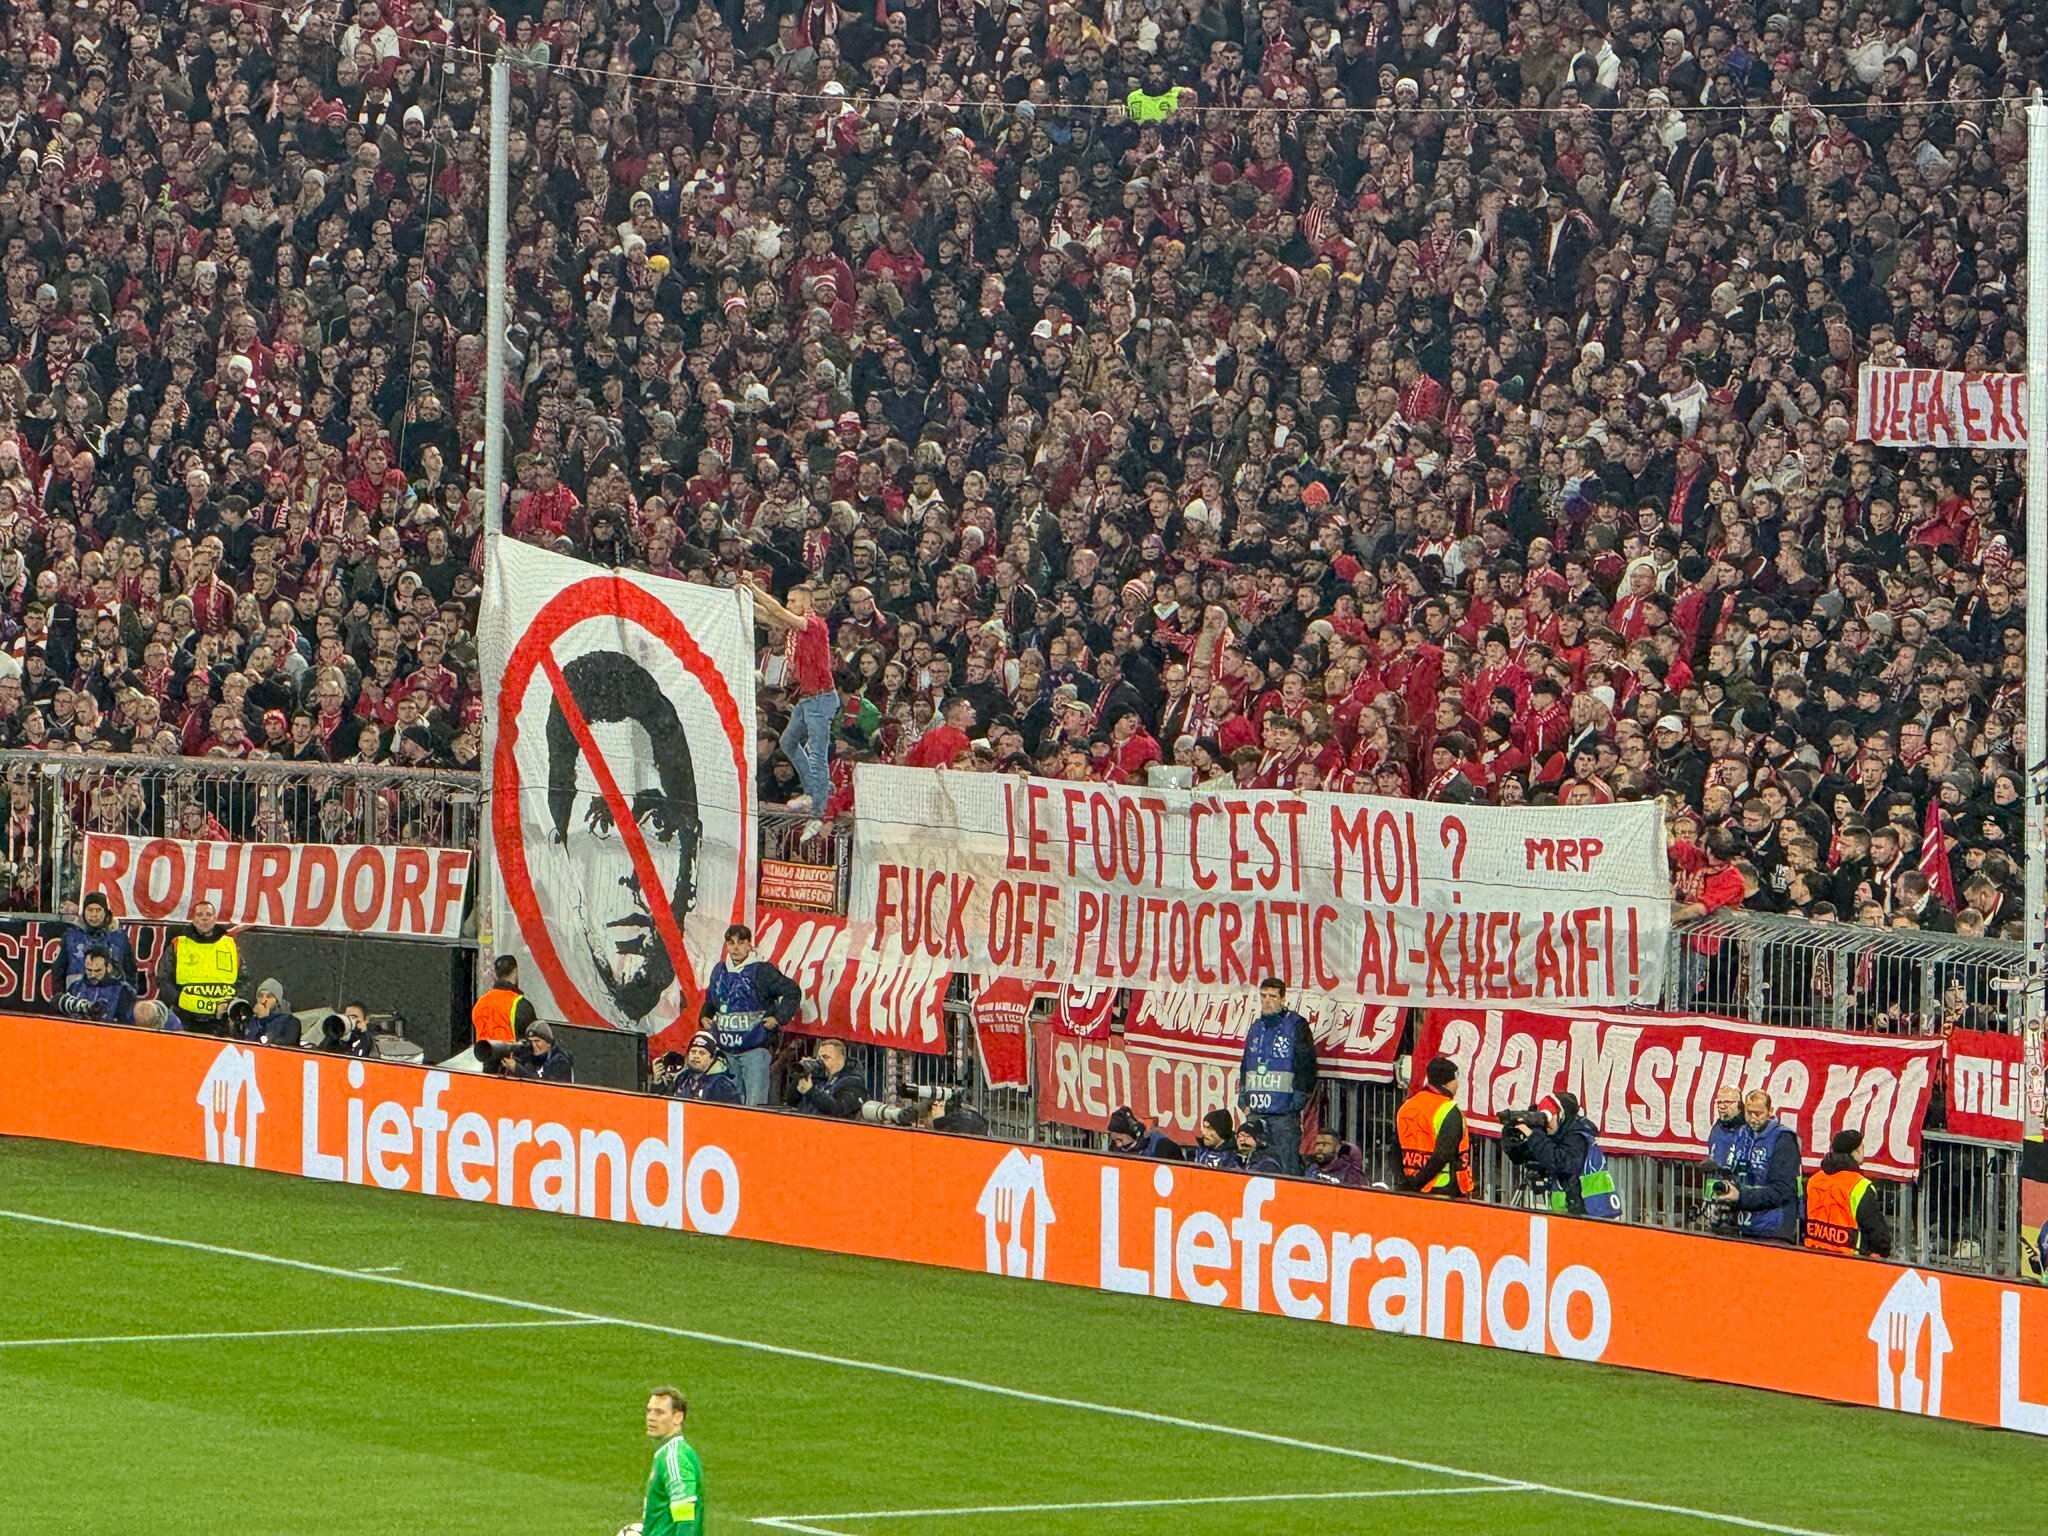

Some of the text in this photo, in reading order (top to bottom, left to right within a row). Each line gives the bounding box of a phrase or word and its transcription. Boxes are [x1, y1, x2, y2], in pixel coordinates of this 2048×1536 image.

[1870, 370, 1958, 444] UEFA
[84, 834, 469, 934] ROHRDORF
[1004, 783, 1467, 906] LE FOOT C'EST MOI ?
[1525, 837, 1603, 872] MRP
[872, 864, 975, 959] FUCK
[987, 880, 1060, 980] OFF,
[1073, 891, 1339, 991] PLUTOCRATIC
[1055, 1041, 1132, 1117] RED
[302, 1059, 740, 1236] Lieferando
[1100, 1164, 1612, 1362] Lieferando
